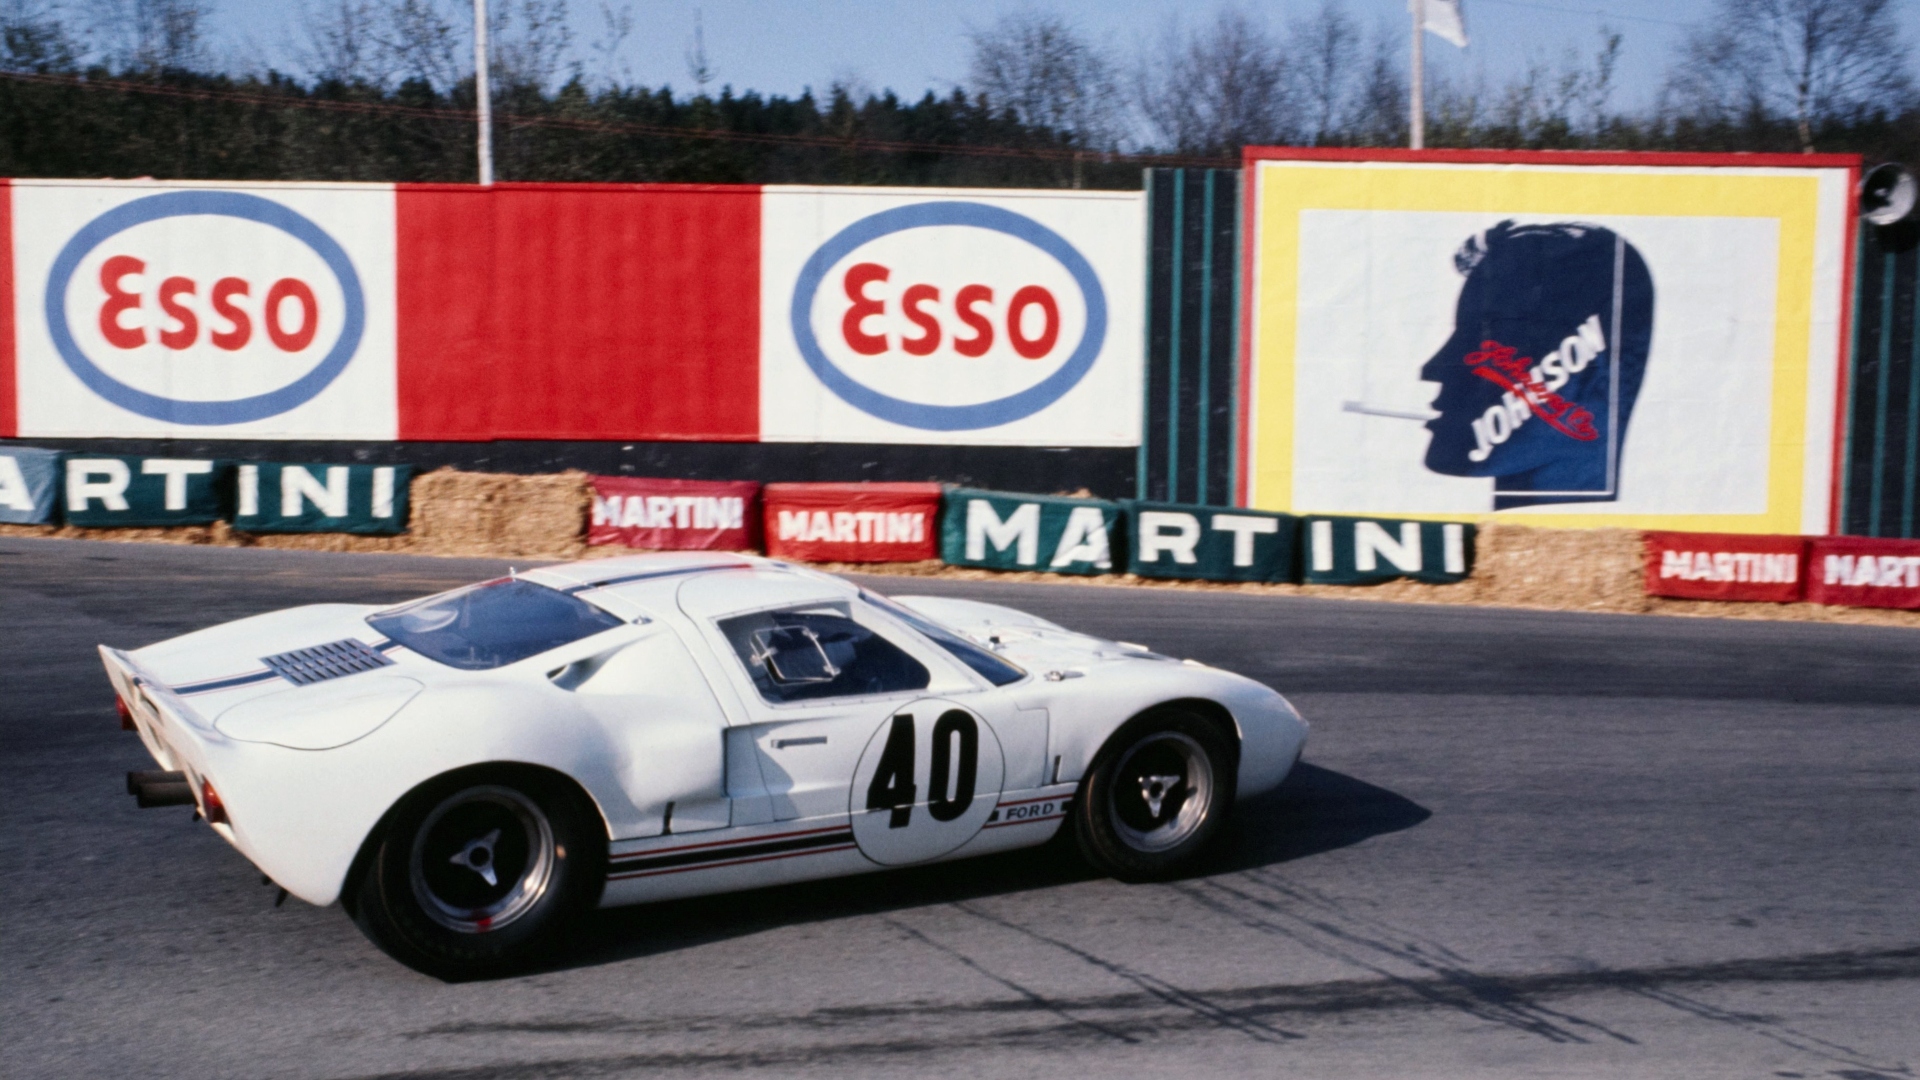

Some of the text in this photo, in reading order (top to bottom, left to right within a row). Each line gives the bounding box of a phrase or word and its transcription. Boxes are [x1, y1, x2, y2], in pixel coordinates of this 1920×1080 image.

[1467, 314, 1606, 462] JOHNSON
[592, 495, 744, 531] MARTINI
[778, 510, 924, 543] MARTINI
[965, 499, 1465, 573] MARTINI
[1660, 550, 1798, 583] MARTINI
[866, 709, 979, 829] 40
[1006, 803, 1054, 820] FORD
